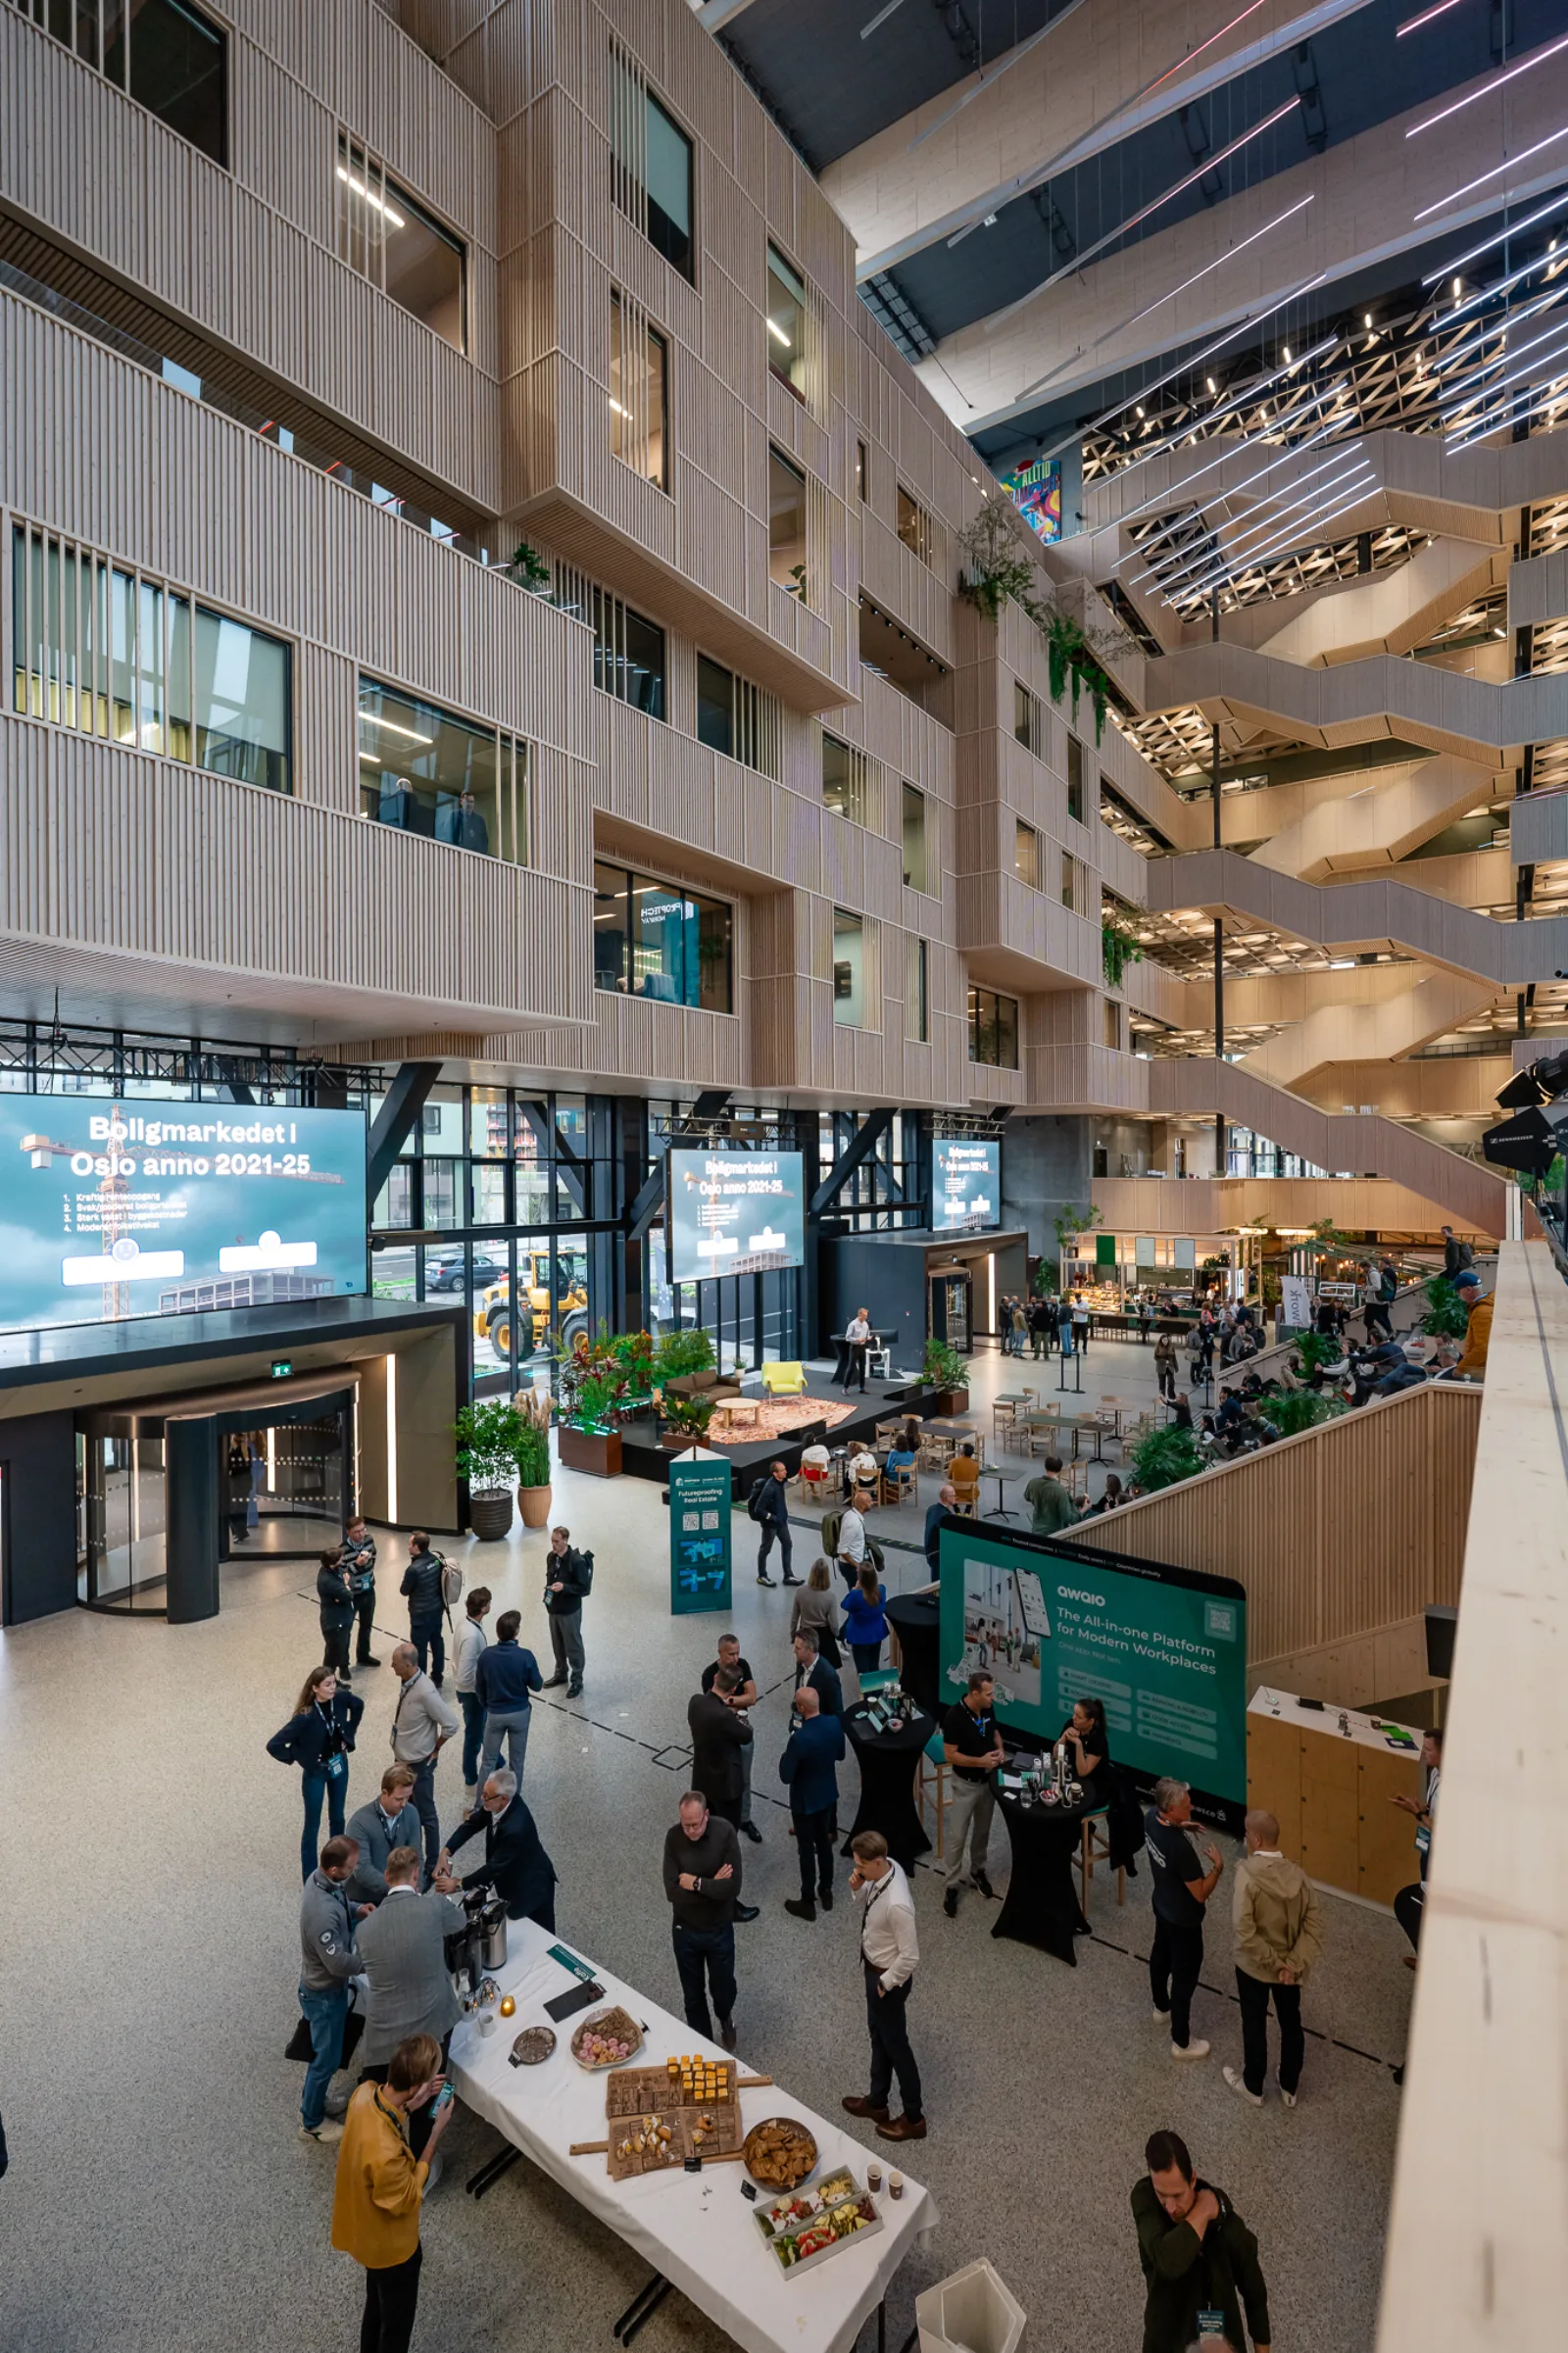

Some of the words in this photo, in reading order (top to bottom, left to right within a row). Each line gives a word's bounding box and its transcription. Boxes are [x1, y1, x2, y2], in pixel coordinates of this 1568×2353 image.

[1022, 461, 1051, 487] ALLTID
[89, 1115, 285, 1146] Boligmarkedet
[290, 1123, 296, 1144] i
[71, 1152, 136, 1176] Oslo
[143, 1156, 209, 1175] anno
[215, 1152, 311, 1175] 2021-25
[706, 1160, 773, 1177] Boligmarkedet
[699, 1179, 721, 1196] Oslo
[722, 1182, 747, 1194] anno
[748, 1179, 783, 1194] 2021-25
[63, 1194, 71, 1202] 1.
[63, 1203, 72, 1213] 2.
[64, 1213, 72, 1223] 3.
[64, 1224, 72, 1233] 4.
[678, 1488, 723, 1497] Futureproofing
[1056, 1606, 1081, 1623] The
[1083, 1613, 1150, 1642] All-in-one
[1152, 1631, 1216, 1658] Platform
[1056, 1622, 1075, 1636] for
[1078, 1628, 1130, 1651] Modern
[1133, 1642, 1217, 1675] Workplaces
